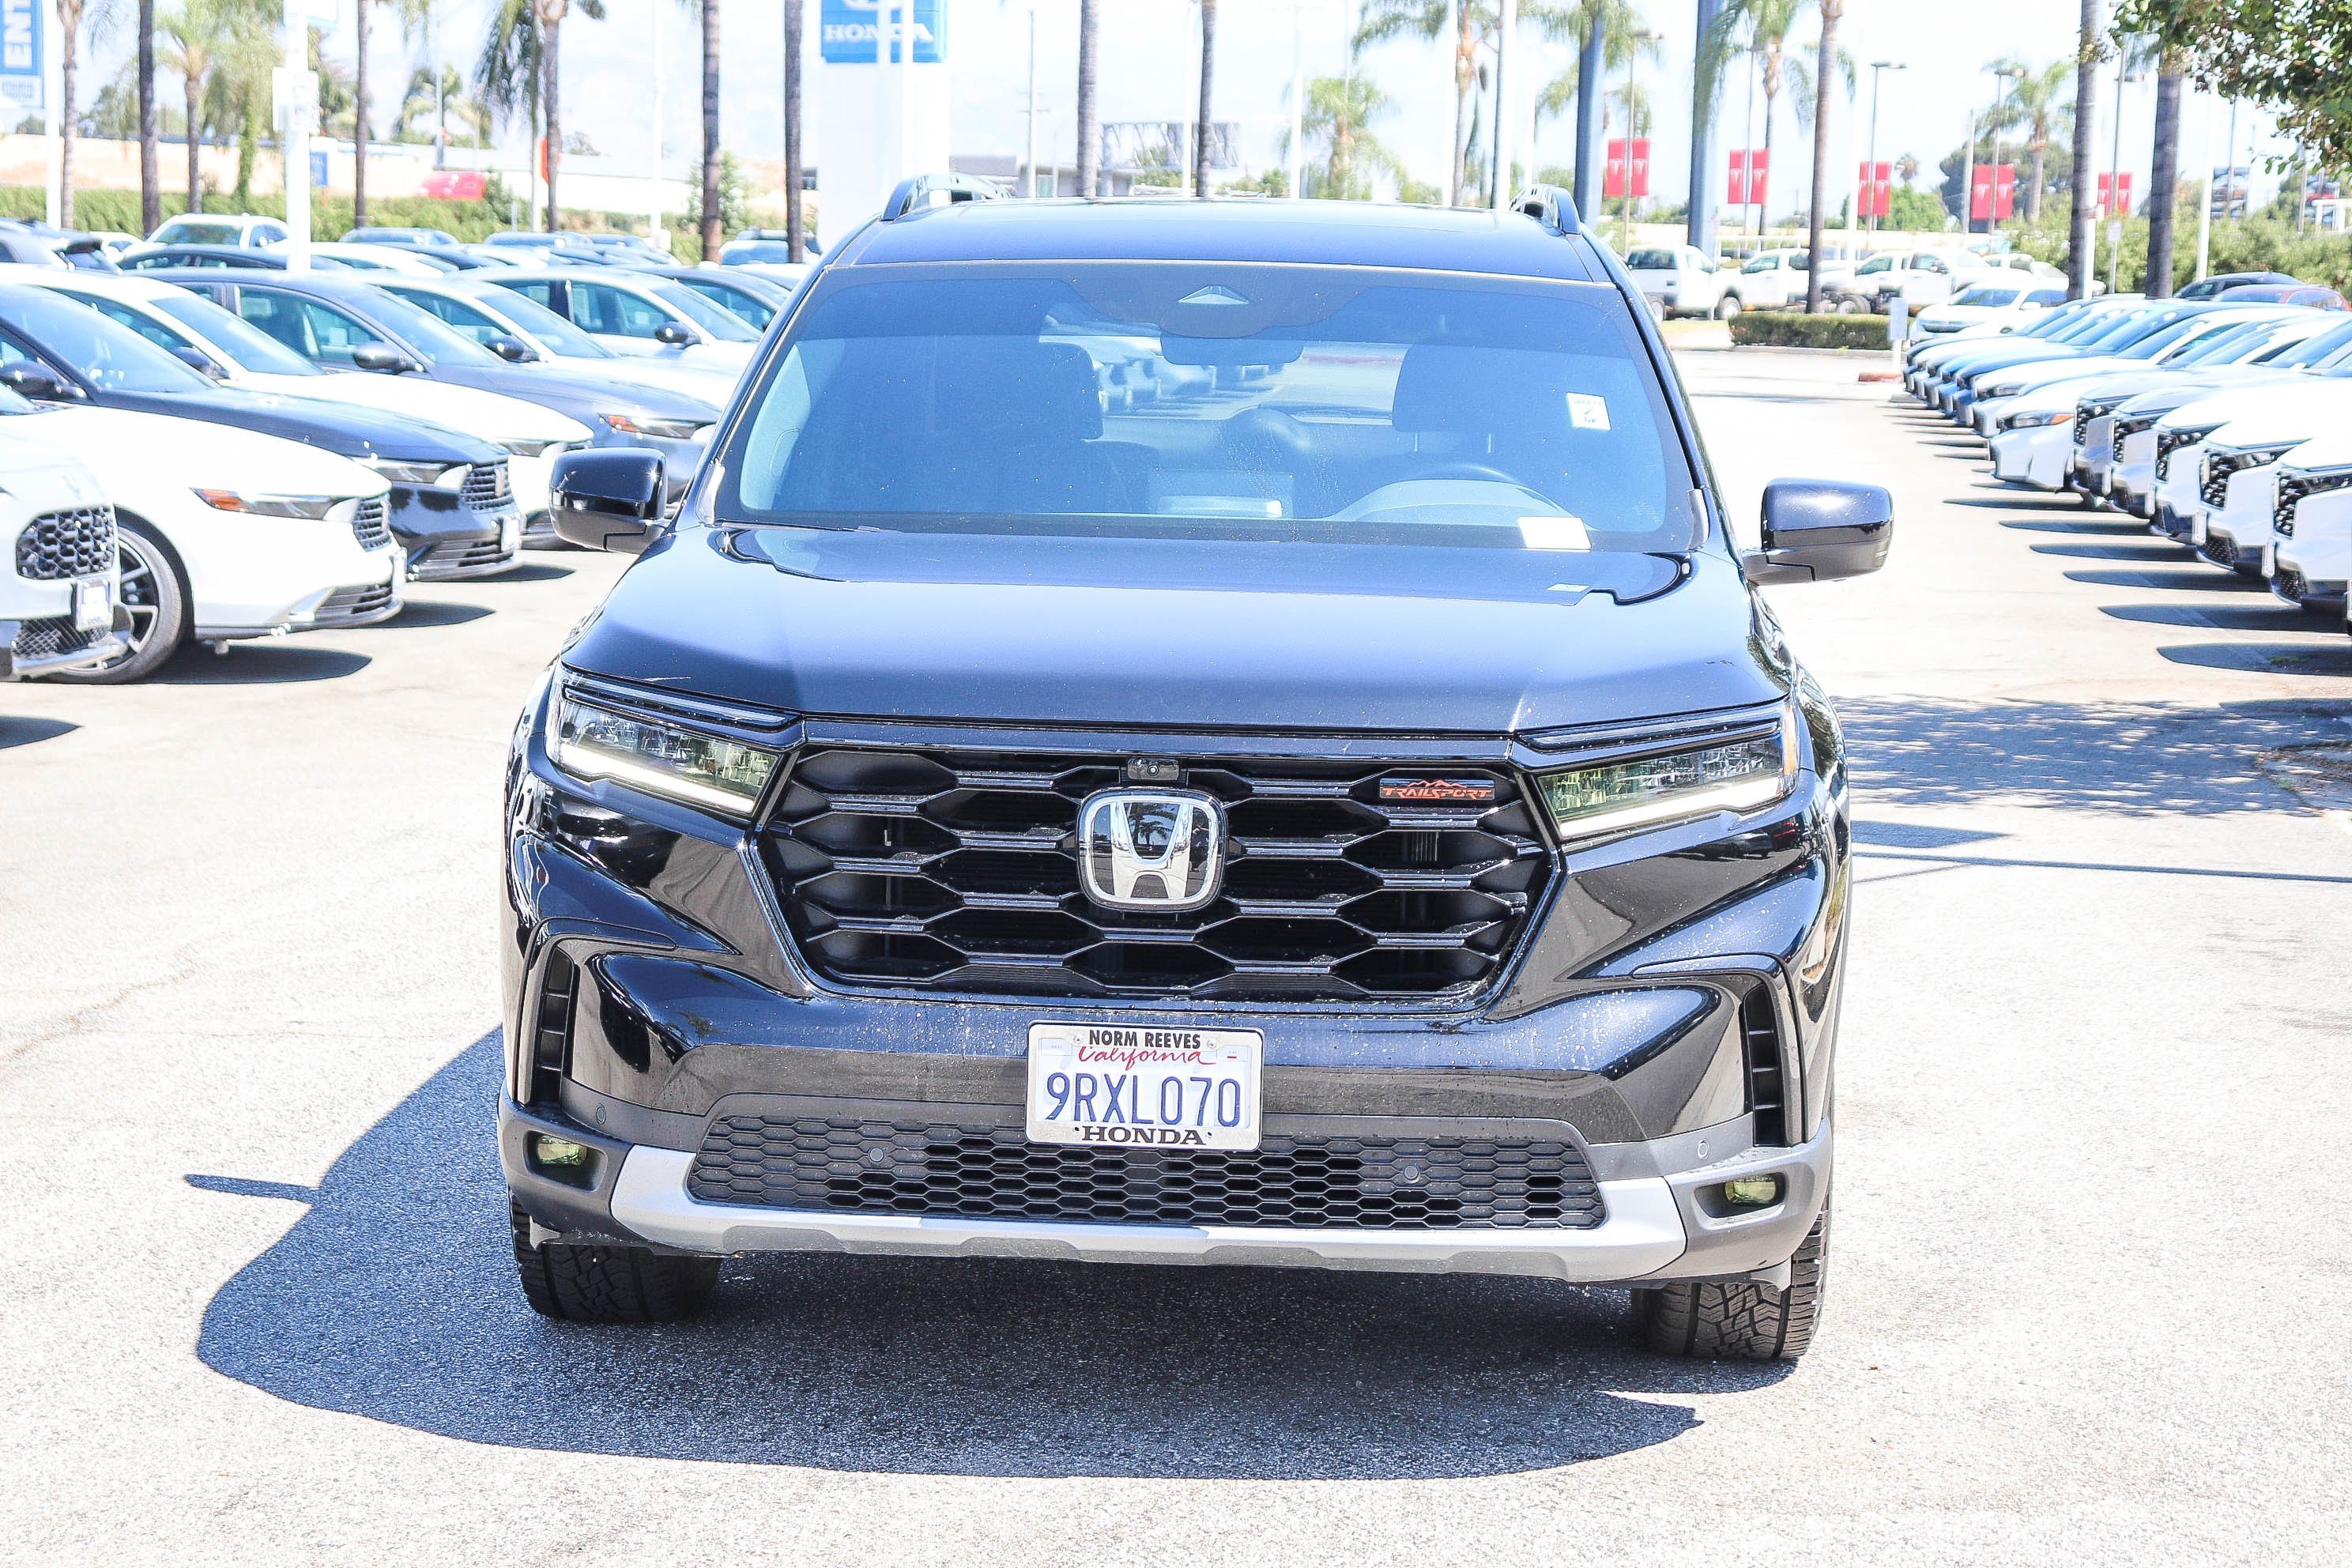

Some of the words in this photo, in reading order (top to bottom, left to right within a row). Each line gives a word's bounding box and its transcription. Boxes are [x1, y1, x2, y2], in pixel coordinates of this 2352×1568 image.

[1382, 787, 1492, 800] TRAILSPORT
[1089, 1030, 1138, 1047] NORM
[1145, 1031, 1201, 1049] REEVES
[1078, 1046, 1216, 1071] California
[1045, 1072, 1241, 1128] 9RXL070
[1081, 1125, 1207, 1146] HONDA
